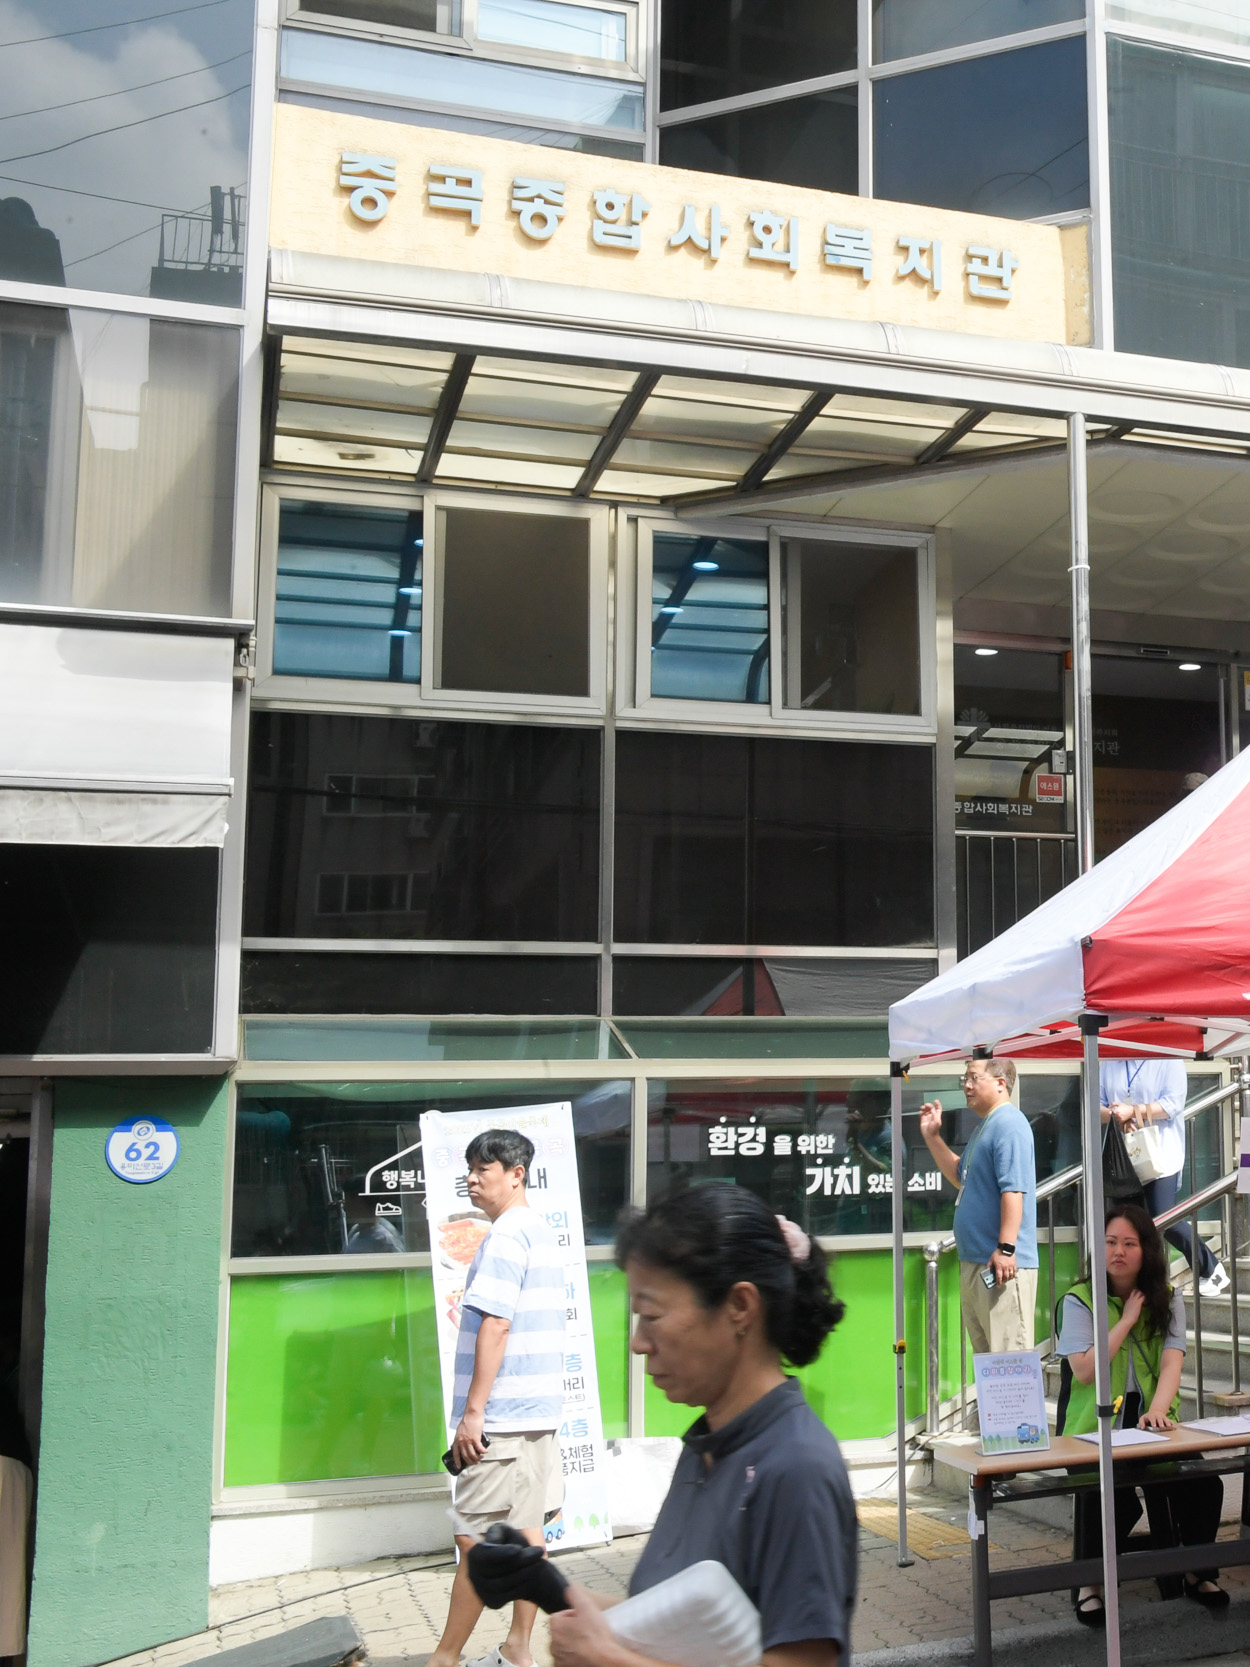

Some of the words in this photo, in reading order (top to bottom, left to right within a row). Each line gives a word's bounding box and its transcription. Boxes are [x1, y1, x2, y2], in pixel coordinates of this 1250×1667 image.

[339, 151, 1019, 301] 중곡종합사회복지관
[124, 1141, 161, 1162] 62
[707, 1116, 767, 1156] 환경
[773, 1135, 792, 1156] 을
[797, 1134, 836, 1155] 위한
[382, 1169, 426, 1190] 행복
[805, 1157, 861, 1196] 가치
[907, 1172, 942, 1192] 소비
